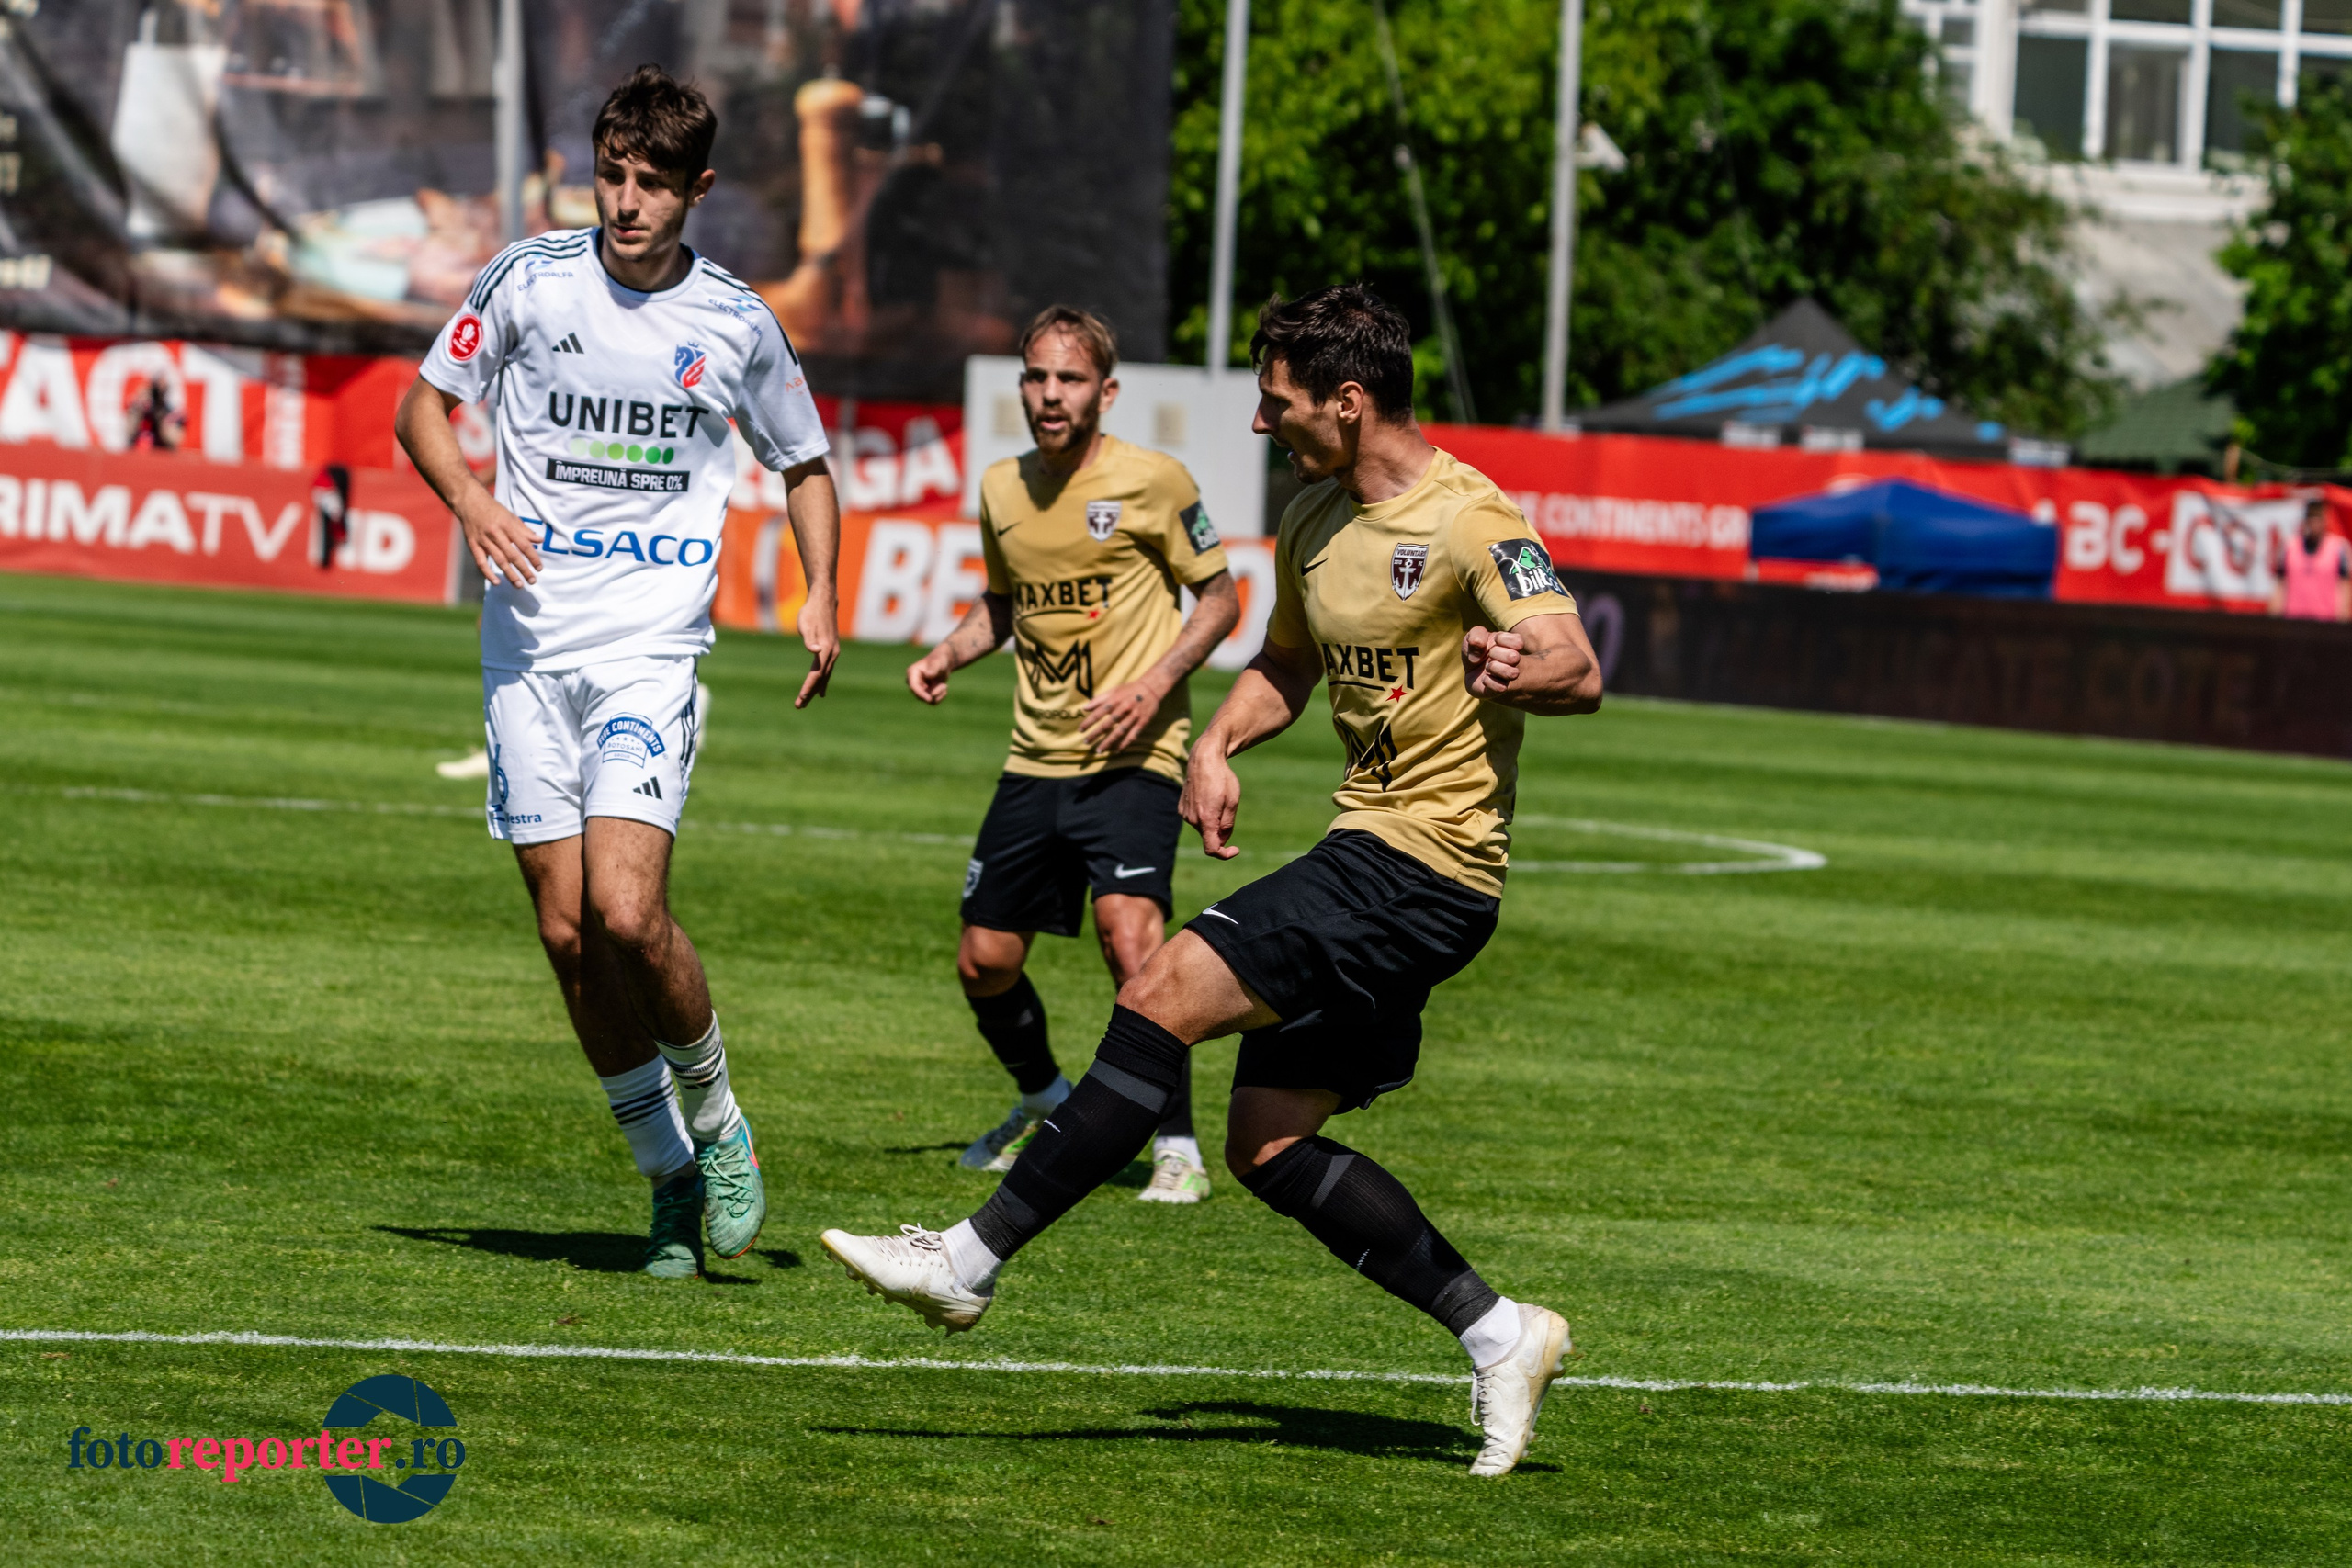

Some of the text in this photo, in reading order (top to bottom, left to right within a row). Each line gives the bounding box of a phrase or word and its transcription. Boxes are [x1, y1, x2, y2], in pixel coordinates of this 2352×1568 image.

[548, 391, 710, 439] UNIBET
[555, 460, 684, 491] ÎMPREUNĂ SPRE 0%
[1321, 643, 1420, 690] AXBET
[598, 720, 662, 753] FIVE CONTINENTS
